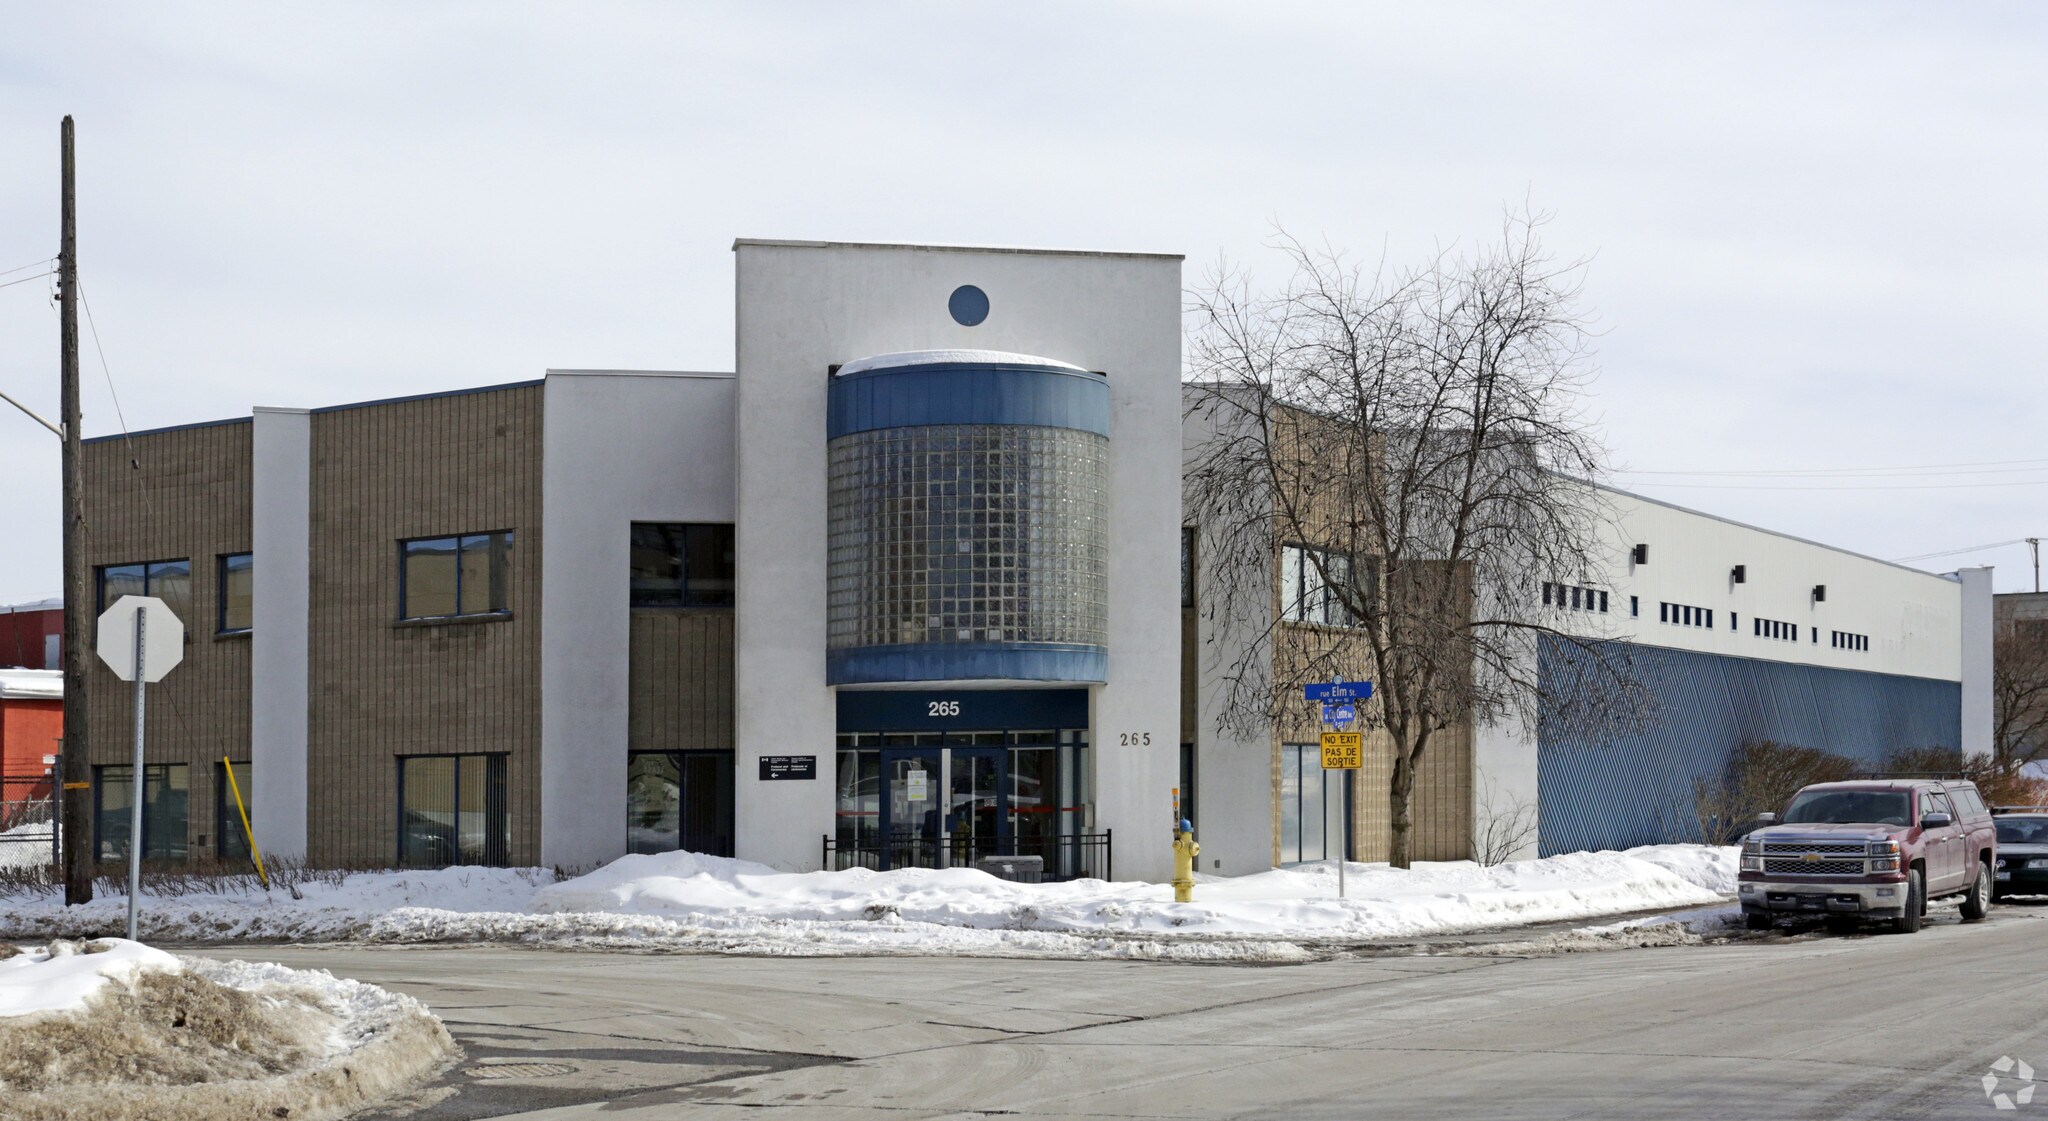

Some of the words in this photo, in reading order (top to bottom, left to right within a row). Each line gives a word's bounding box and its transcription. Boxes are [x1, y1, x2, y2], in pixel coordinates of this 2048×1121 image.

[1332, 685, 1347, 697] Elm
[1349, 689, 1357, 697] St.
[928, 701, 960, 716] 265
[1120, 732, 1151, 746] 265
[1325, 735, 1336, 744] NO
[1340, 735, 1358, 744] EXIT
[1325, 747, 1342, 757] PAS
[1346, 747, 1357, 756] DE
[1327, 757, 1356, 766] SORTIE
